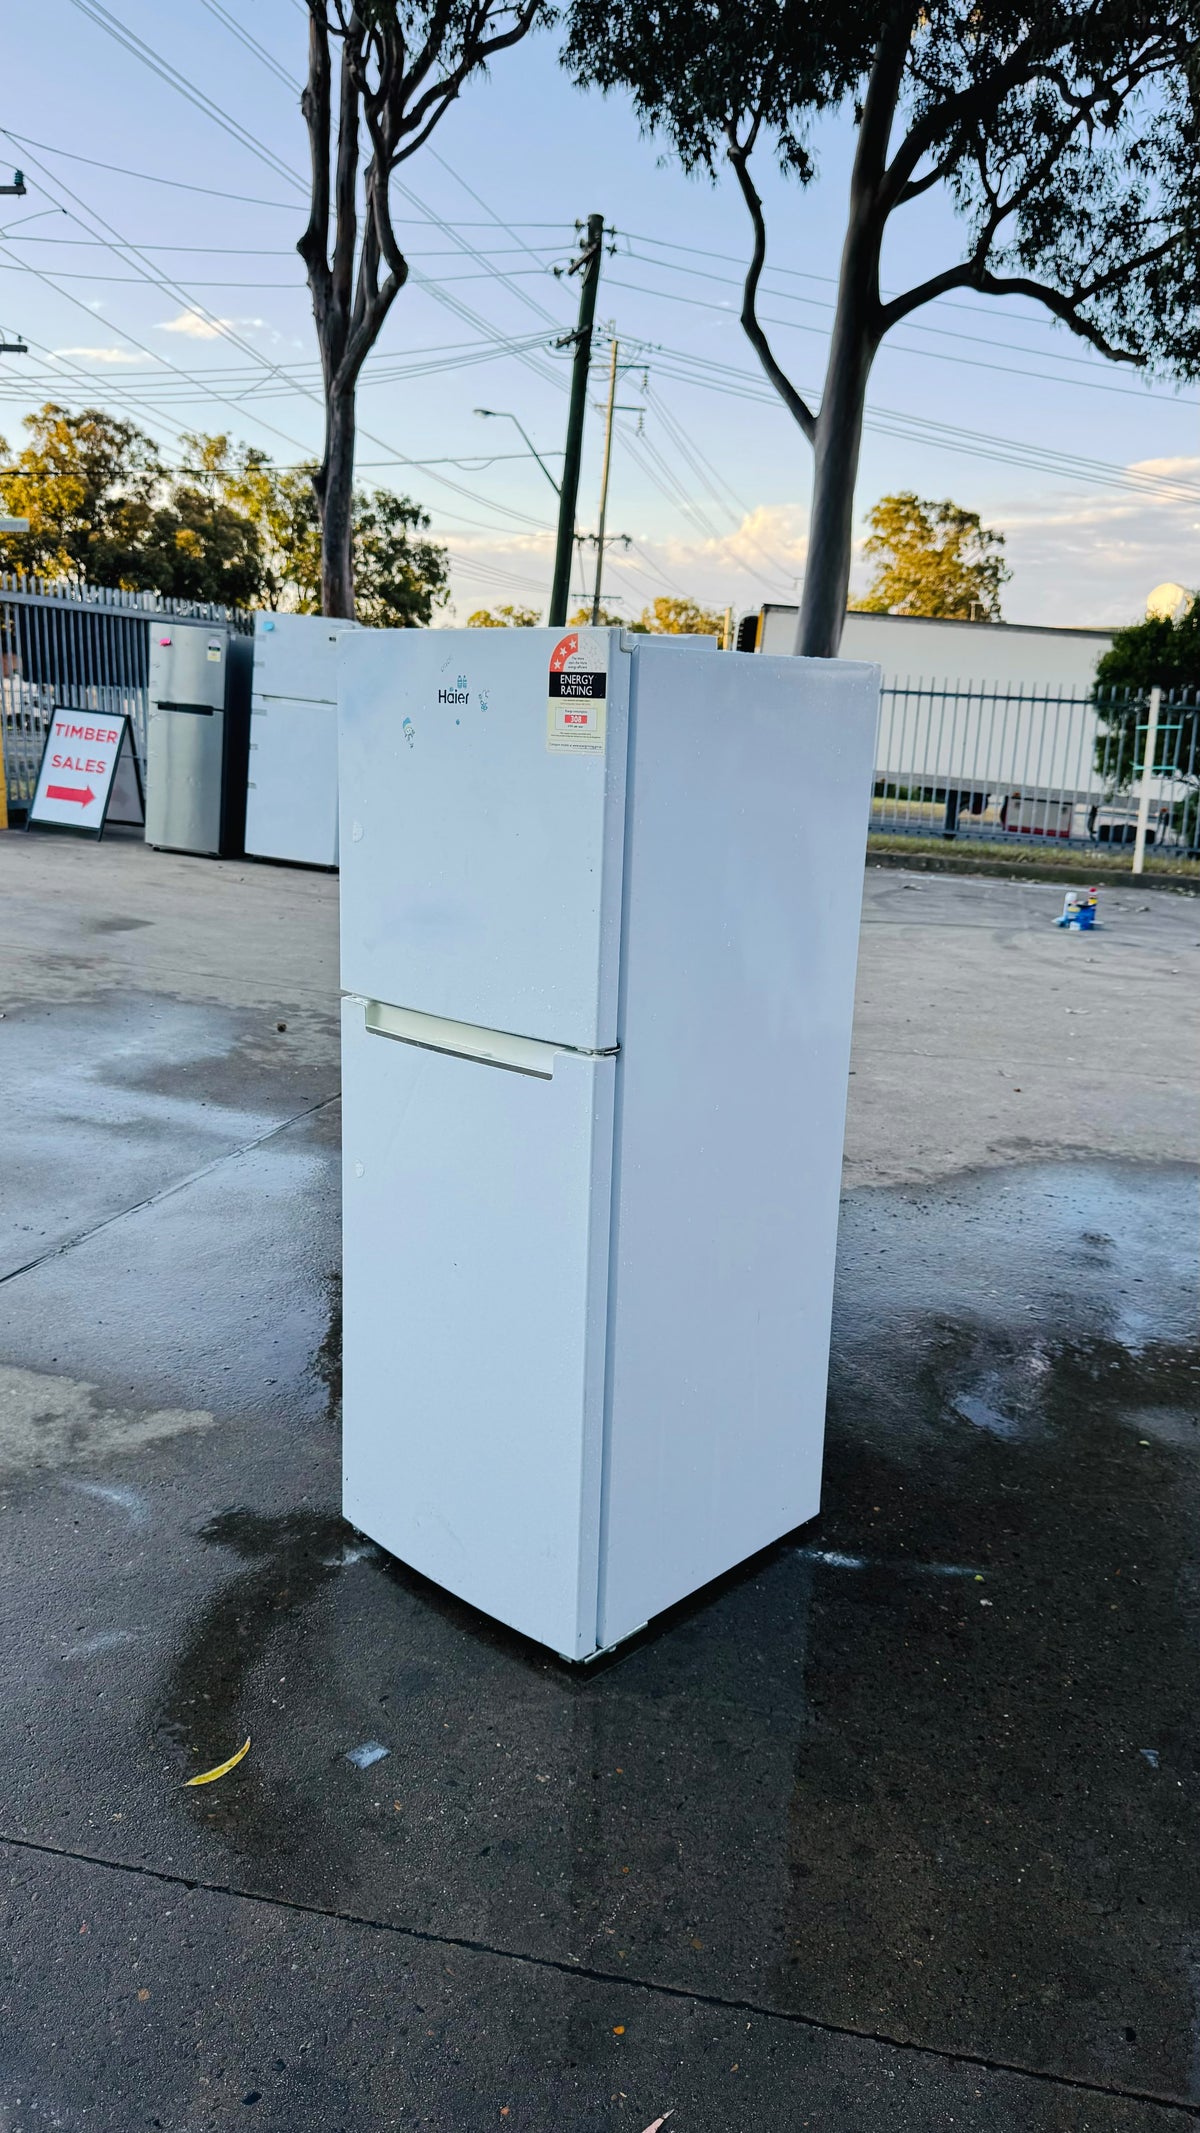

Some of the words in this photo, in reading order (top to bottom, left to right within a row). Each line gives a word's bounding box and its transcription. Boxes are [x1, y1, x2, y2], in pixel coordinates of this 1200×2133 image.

[560, 674, 594, 685] ENERGY
[438, 689, 469, 704] Haier
[560, 685, 592, 696] RATING
[55, 723, 118, 744] TIMBER
[51, 754, 107, 774] SALES
